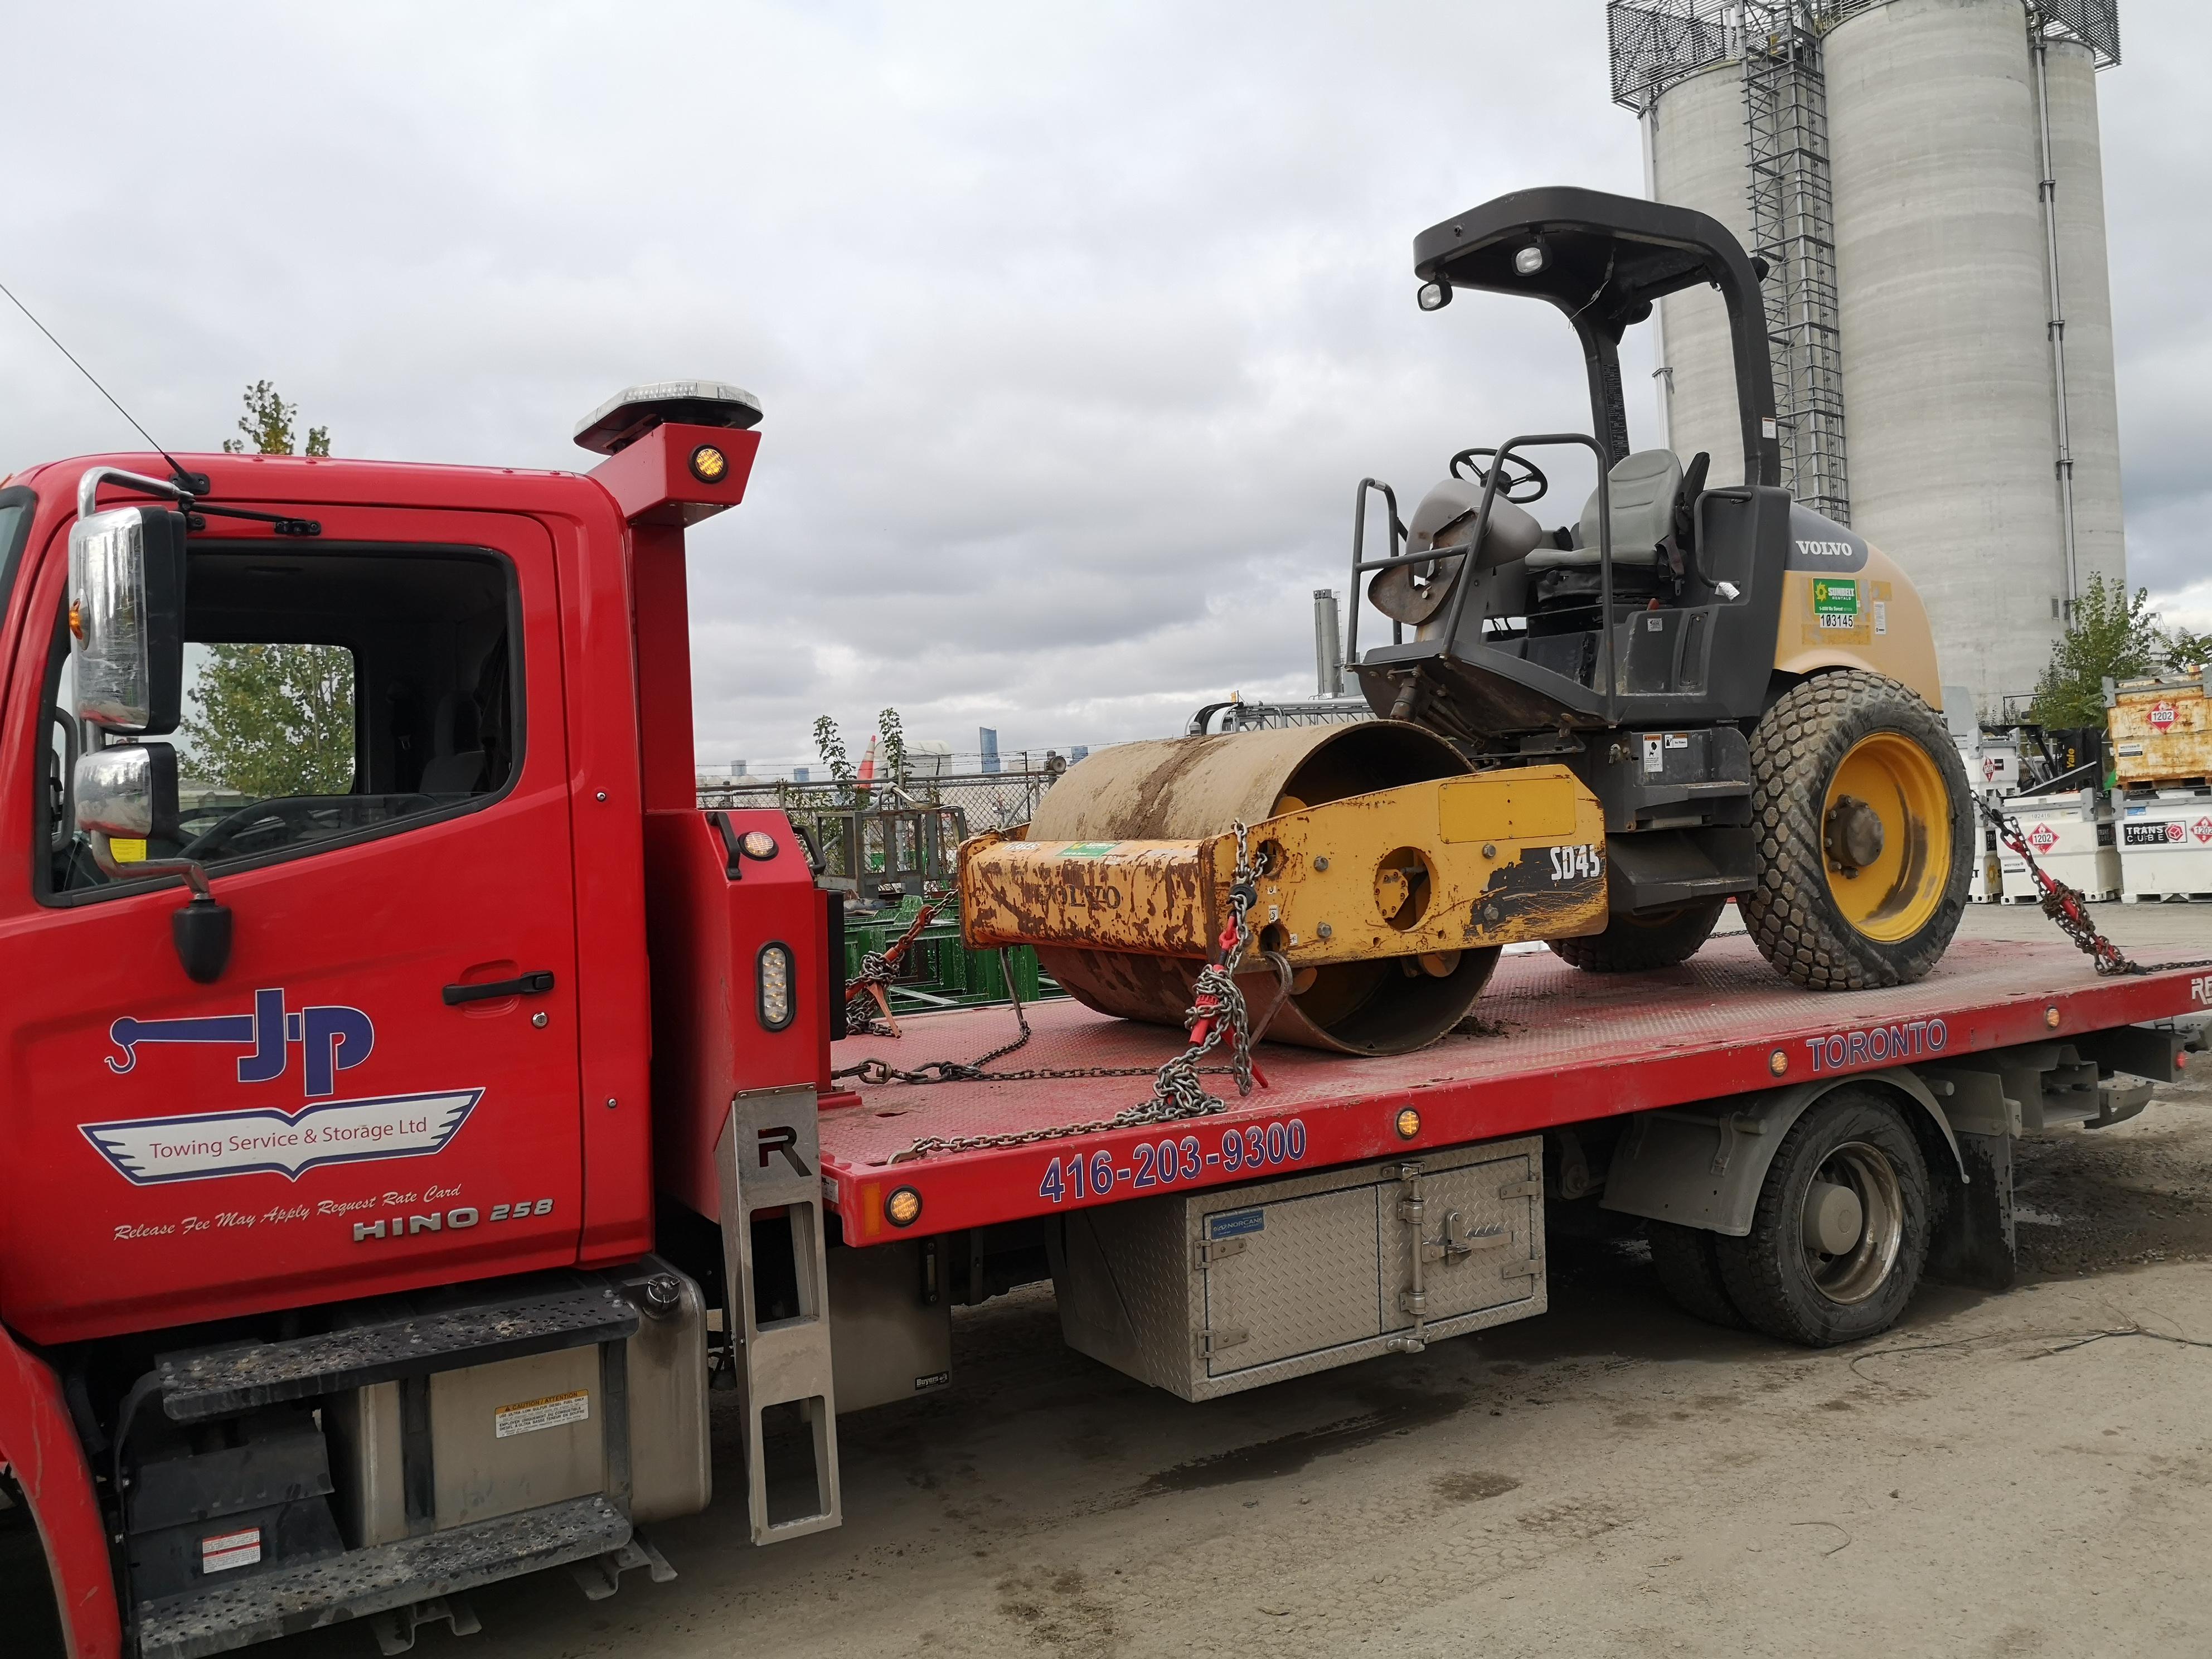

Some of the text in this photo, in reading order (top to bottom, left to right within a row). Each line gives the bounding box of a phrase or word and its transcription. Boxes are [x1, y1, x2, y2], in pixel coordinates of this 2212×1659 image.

[1796, 540, 1852, 556] VOLVO
[1821, 614, 1853, 627] 103145
[2152, 712, 2172, 721] 1202
[2067, 748, 2075, 768] Yale
[2034, 833, 2051, 843] 1202
[2126, 826, 2164, 835] TRANS
[2127, 834, 2164, 842] CUBE
[1550, 845, 1600, 880] SD45
[1806, 1018, 1948, 1071] TORONTO
[149, 1117, 427, 1158] Towing Service & Storage Ltd
[1039, 1118, 1307, 1203] 416-203-9300
[113, 1183, 462, 1241] Release Fee May Apply Request Rate Card
[353, 1198, 555, 1242] HINO 258
[916, 1376, 939, 1386] Buyers
[512, 1400, 540, 1410] CAUTION
[545, 1391, 578, 1403] ATTENTION
[521, 1414, 546, 1422] UNIQUEMENT
[555, 1406, 581, 1415] COMBUSTIBLE
